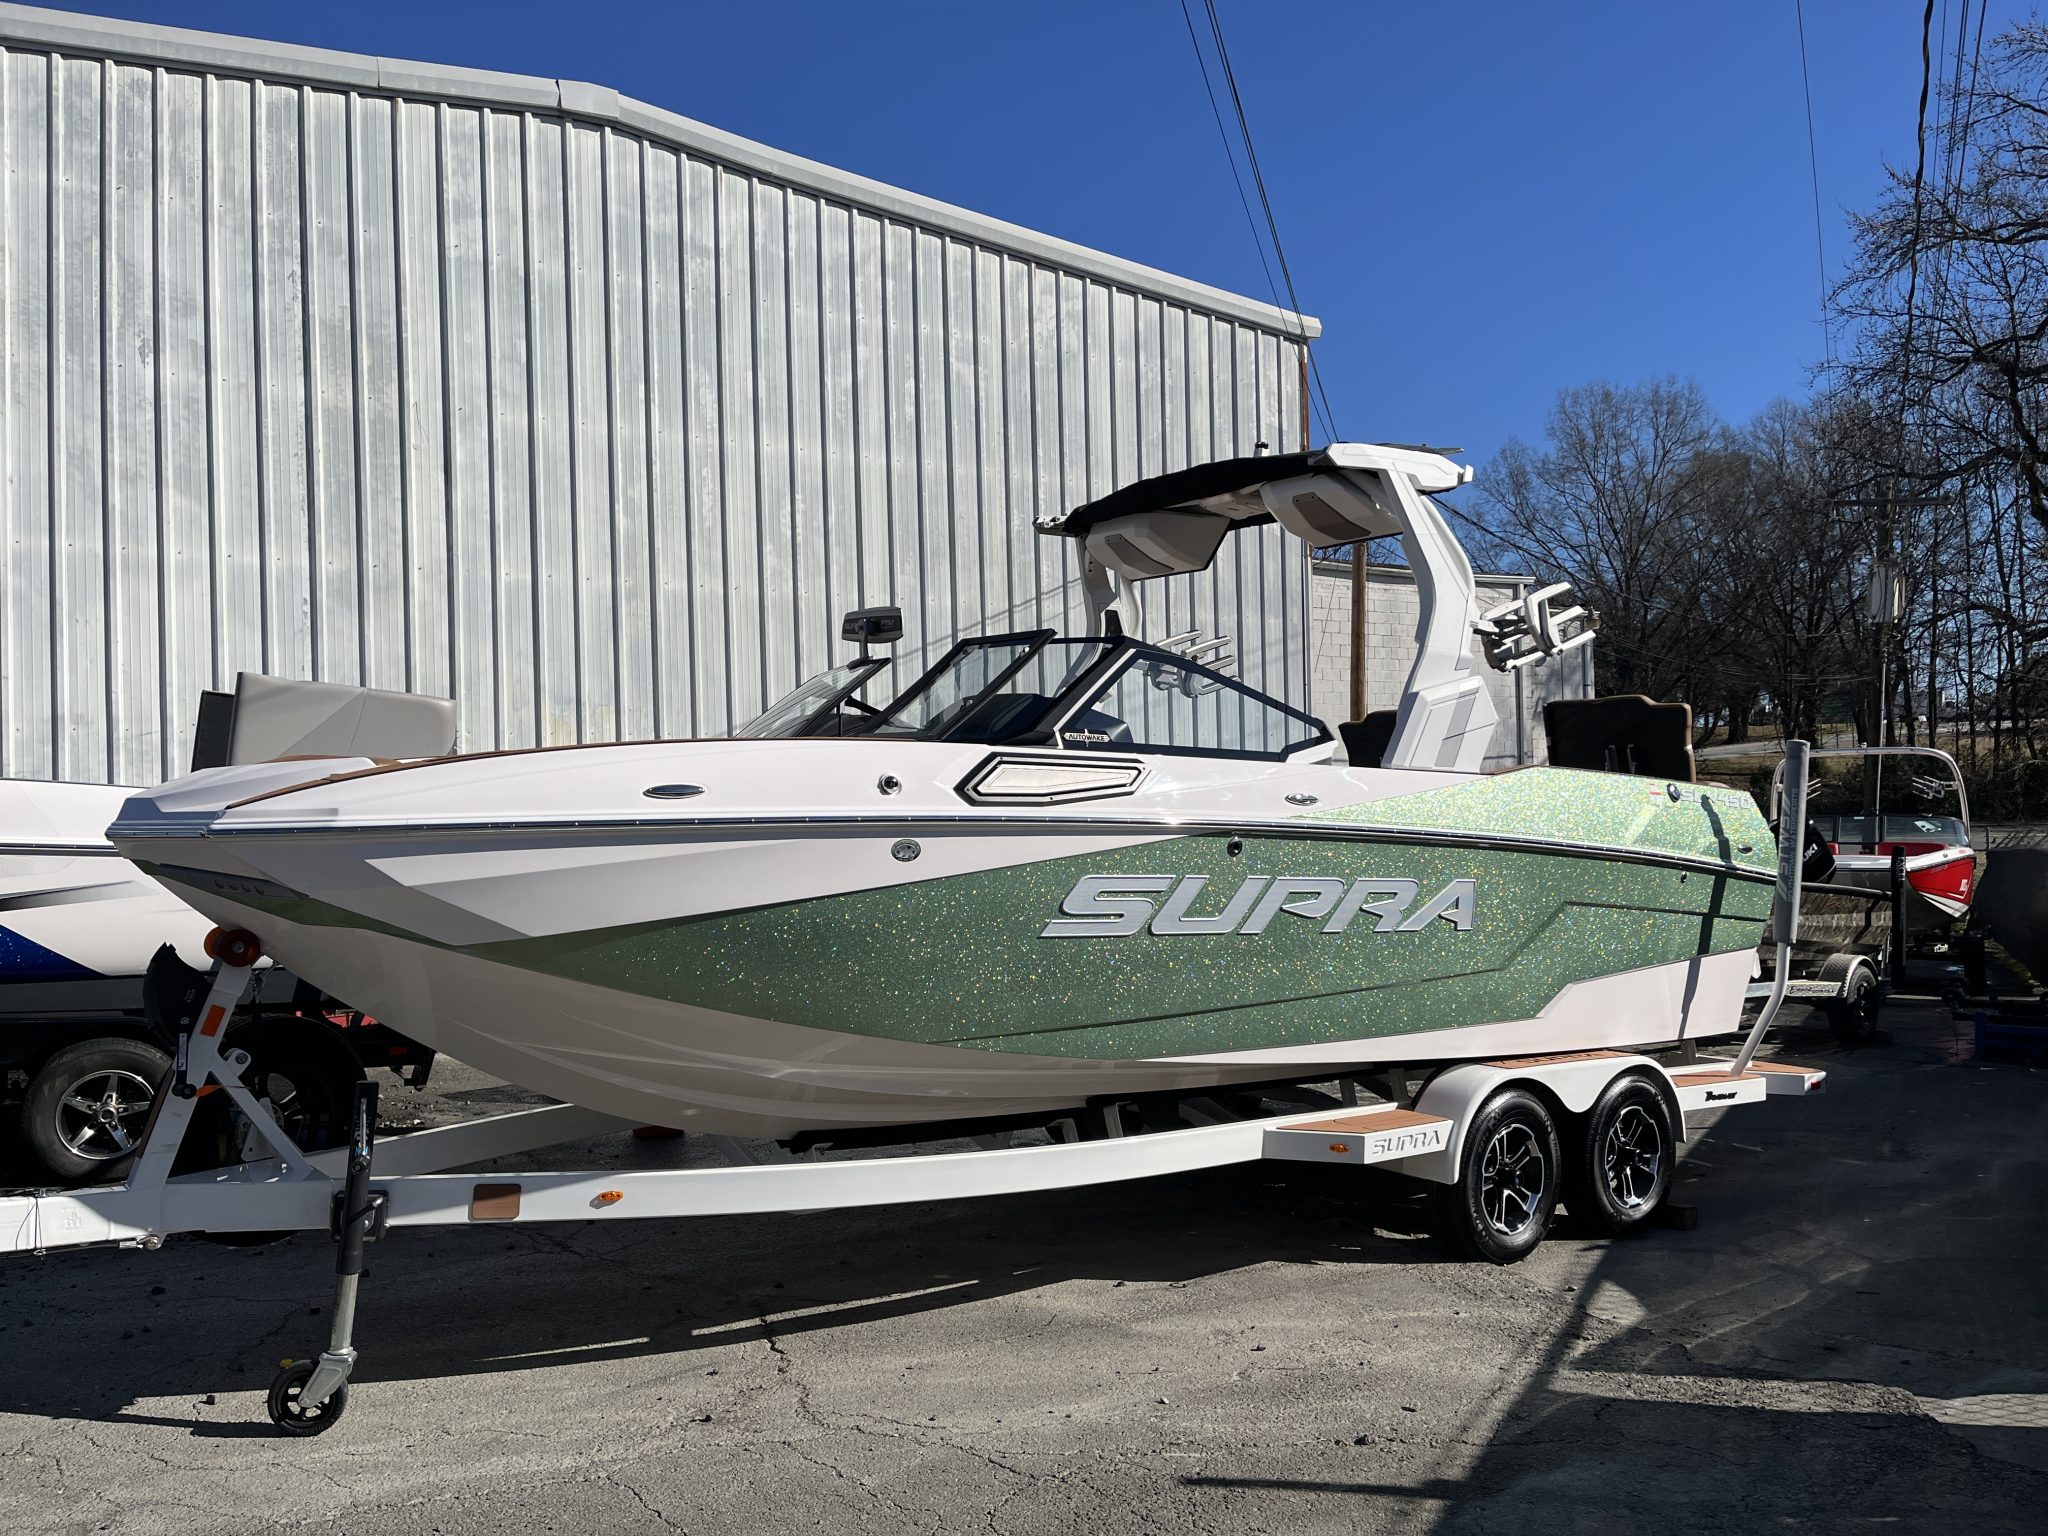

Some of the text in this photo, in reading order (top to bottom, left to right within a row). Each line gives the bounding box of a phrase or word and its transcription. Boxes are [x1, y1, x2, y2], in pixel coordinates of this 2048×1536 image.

[1068, 733, 1105, 742] AUTOWAKE
[1037, 874, 1477, 937] SUPRA
[1371, 1129, 1441, 1155] SUPRA
